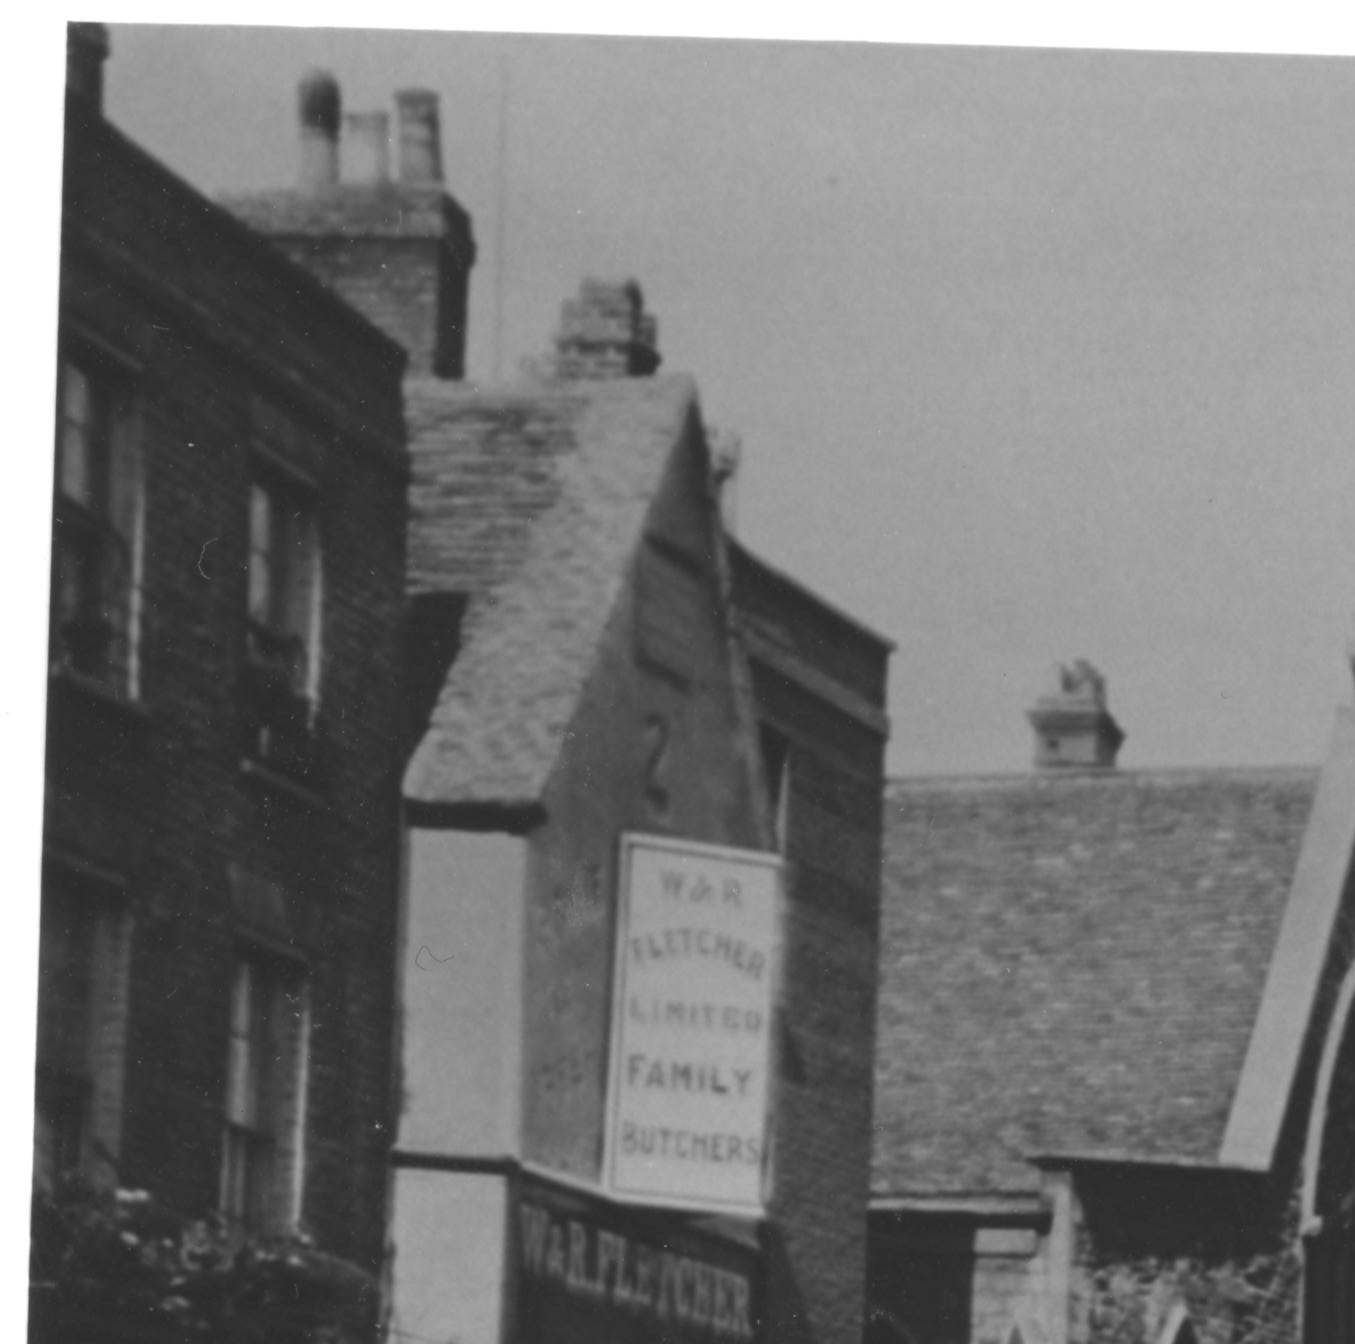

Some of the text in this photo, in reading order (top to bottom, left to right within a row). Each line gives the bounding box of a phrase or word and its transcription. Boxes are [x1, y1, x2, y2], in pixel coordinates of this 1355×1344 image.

[630, 926, 768, 982] FLETCHER
[629, 995, 764, 1034] LIMITED
[626, 1052, 753, 1097] FAMILY
[621, 1118, 763, 1167] BUTCHERS
